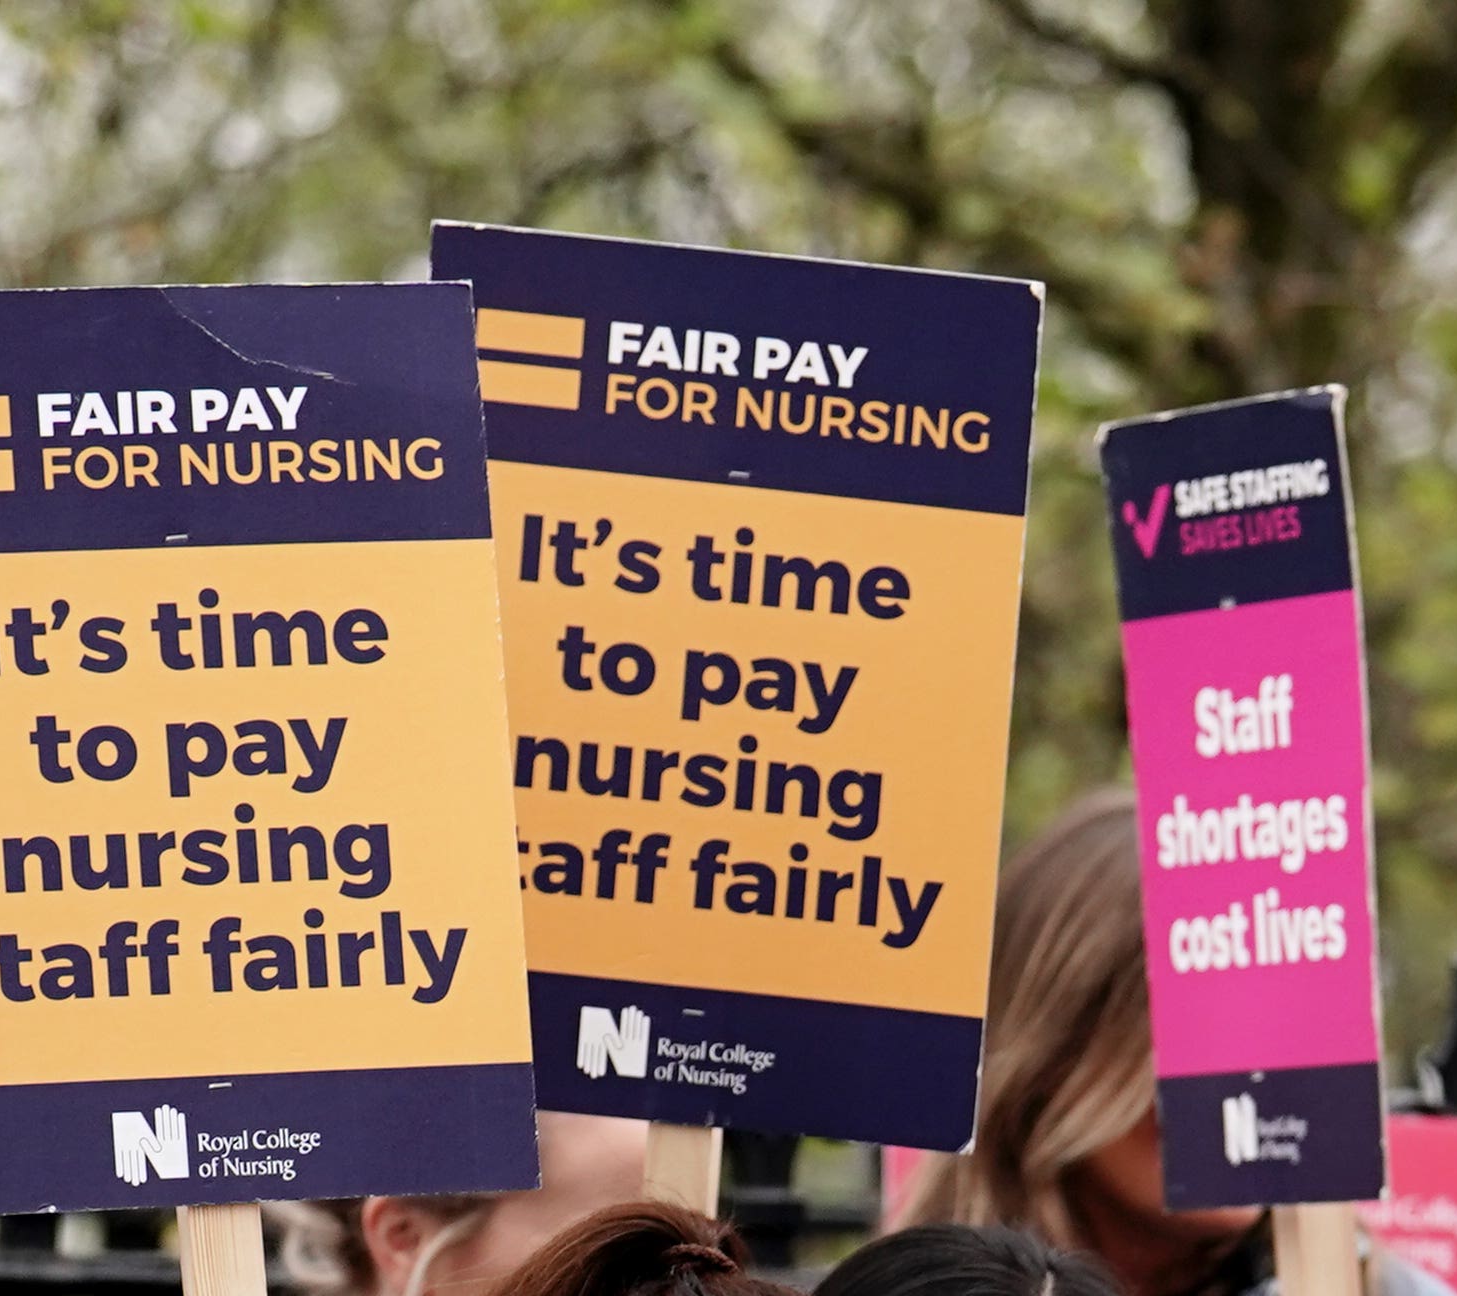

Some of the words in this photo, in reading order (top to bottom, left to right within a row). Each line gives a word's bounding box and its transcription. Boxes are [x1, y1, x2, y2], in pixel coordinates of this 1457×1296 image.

[608, 321, 740, 377] FAIR
[753, 337, 868, 388] PAY
[38, 390, 176, 438] FAIR
[191, 386, 307, 432] PAY
[605, 373, 716, 425] FOR
[735, 386, 991, 454] NURSING
[43, 446, 160, 491] FOR
[181, 437, 444, 486] NURSING
[1174, 475, 1228, 519] SAFE
[1230, 458, 1329, 511] STAFFING
[519, 513, 662, 594] It's
[687, 527, 910, 621] time
[1180, 514, 1242, 556] SAVES
[1245, 505, 1301, 546] LIVES
[151, 588, 390, 671] time
[557, 625, 656, 697] to
[680, 649, 860, 734] pay
[1194, 673, 1293, 758] Staff
[30, 715, 137, 783] to
[165, 717, 348, 798] pay
[513, 734, 883, 841] nursing
[2, 802, 391, 898] nursing
[1156, 794, 1347, 873] shortages
[516, 825, 671, 903] aff
[691, 839, 944, 949] fairly
[203, 908, 468, 1004] fairly
[1169, 902, 1249, 973] cost
[1254, 887, 1346, 966] lives
[654, 1063, 675, 1082] of
[678, 1064, 747, 1093] Nursing
[657, 1037, 706, 1062] Royal
[709, 1041, 775, 1069] College
[198, 1130, 248, 1154] Royal
[253, 1128, 321, 1152] College
[199, 1157, 222, 1178] of
[224, 1154, 295, 1181] Nursing
